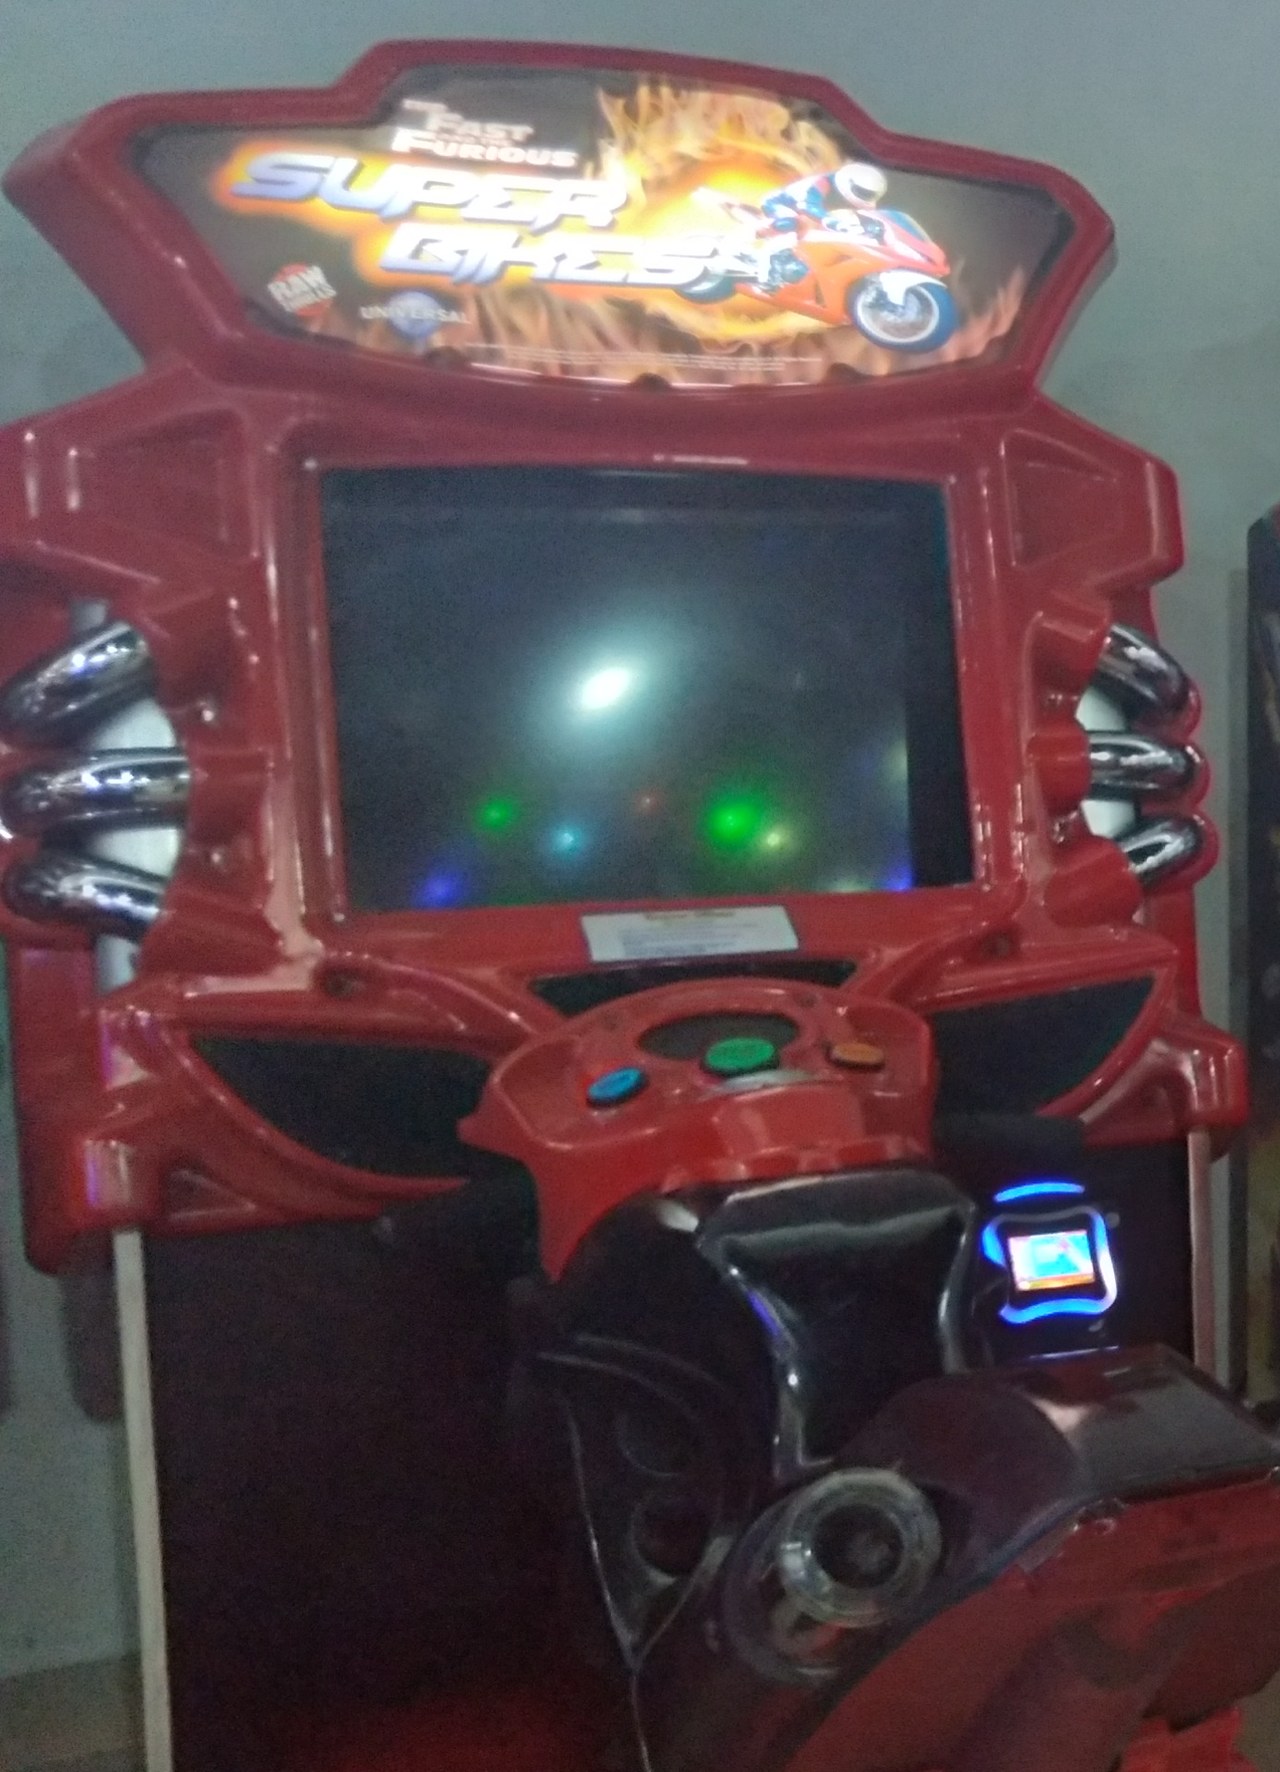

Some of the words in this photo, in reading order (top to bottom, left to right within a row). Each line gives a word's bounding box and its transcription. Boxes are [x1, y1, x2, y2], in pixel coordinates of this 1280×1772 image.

[391, 127, 579, 168] FURIOUS
[230, 151, 630, 234] SUPER
[380, 222, 722, 288] BIKES
[359, 304, 472, 326] UNIVERSAL
